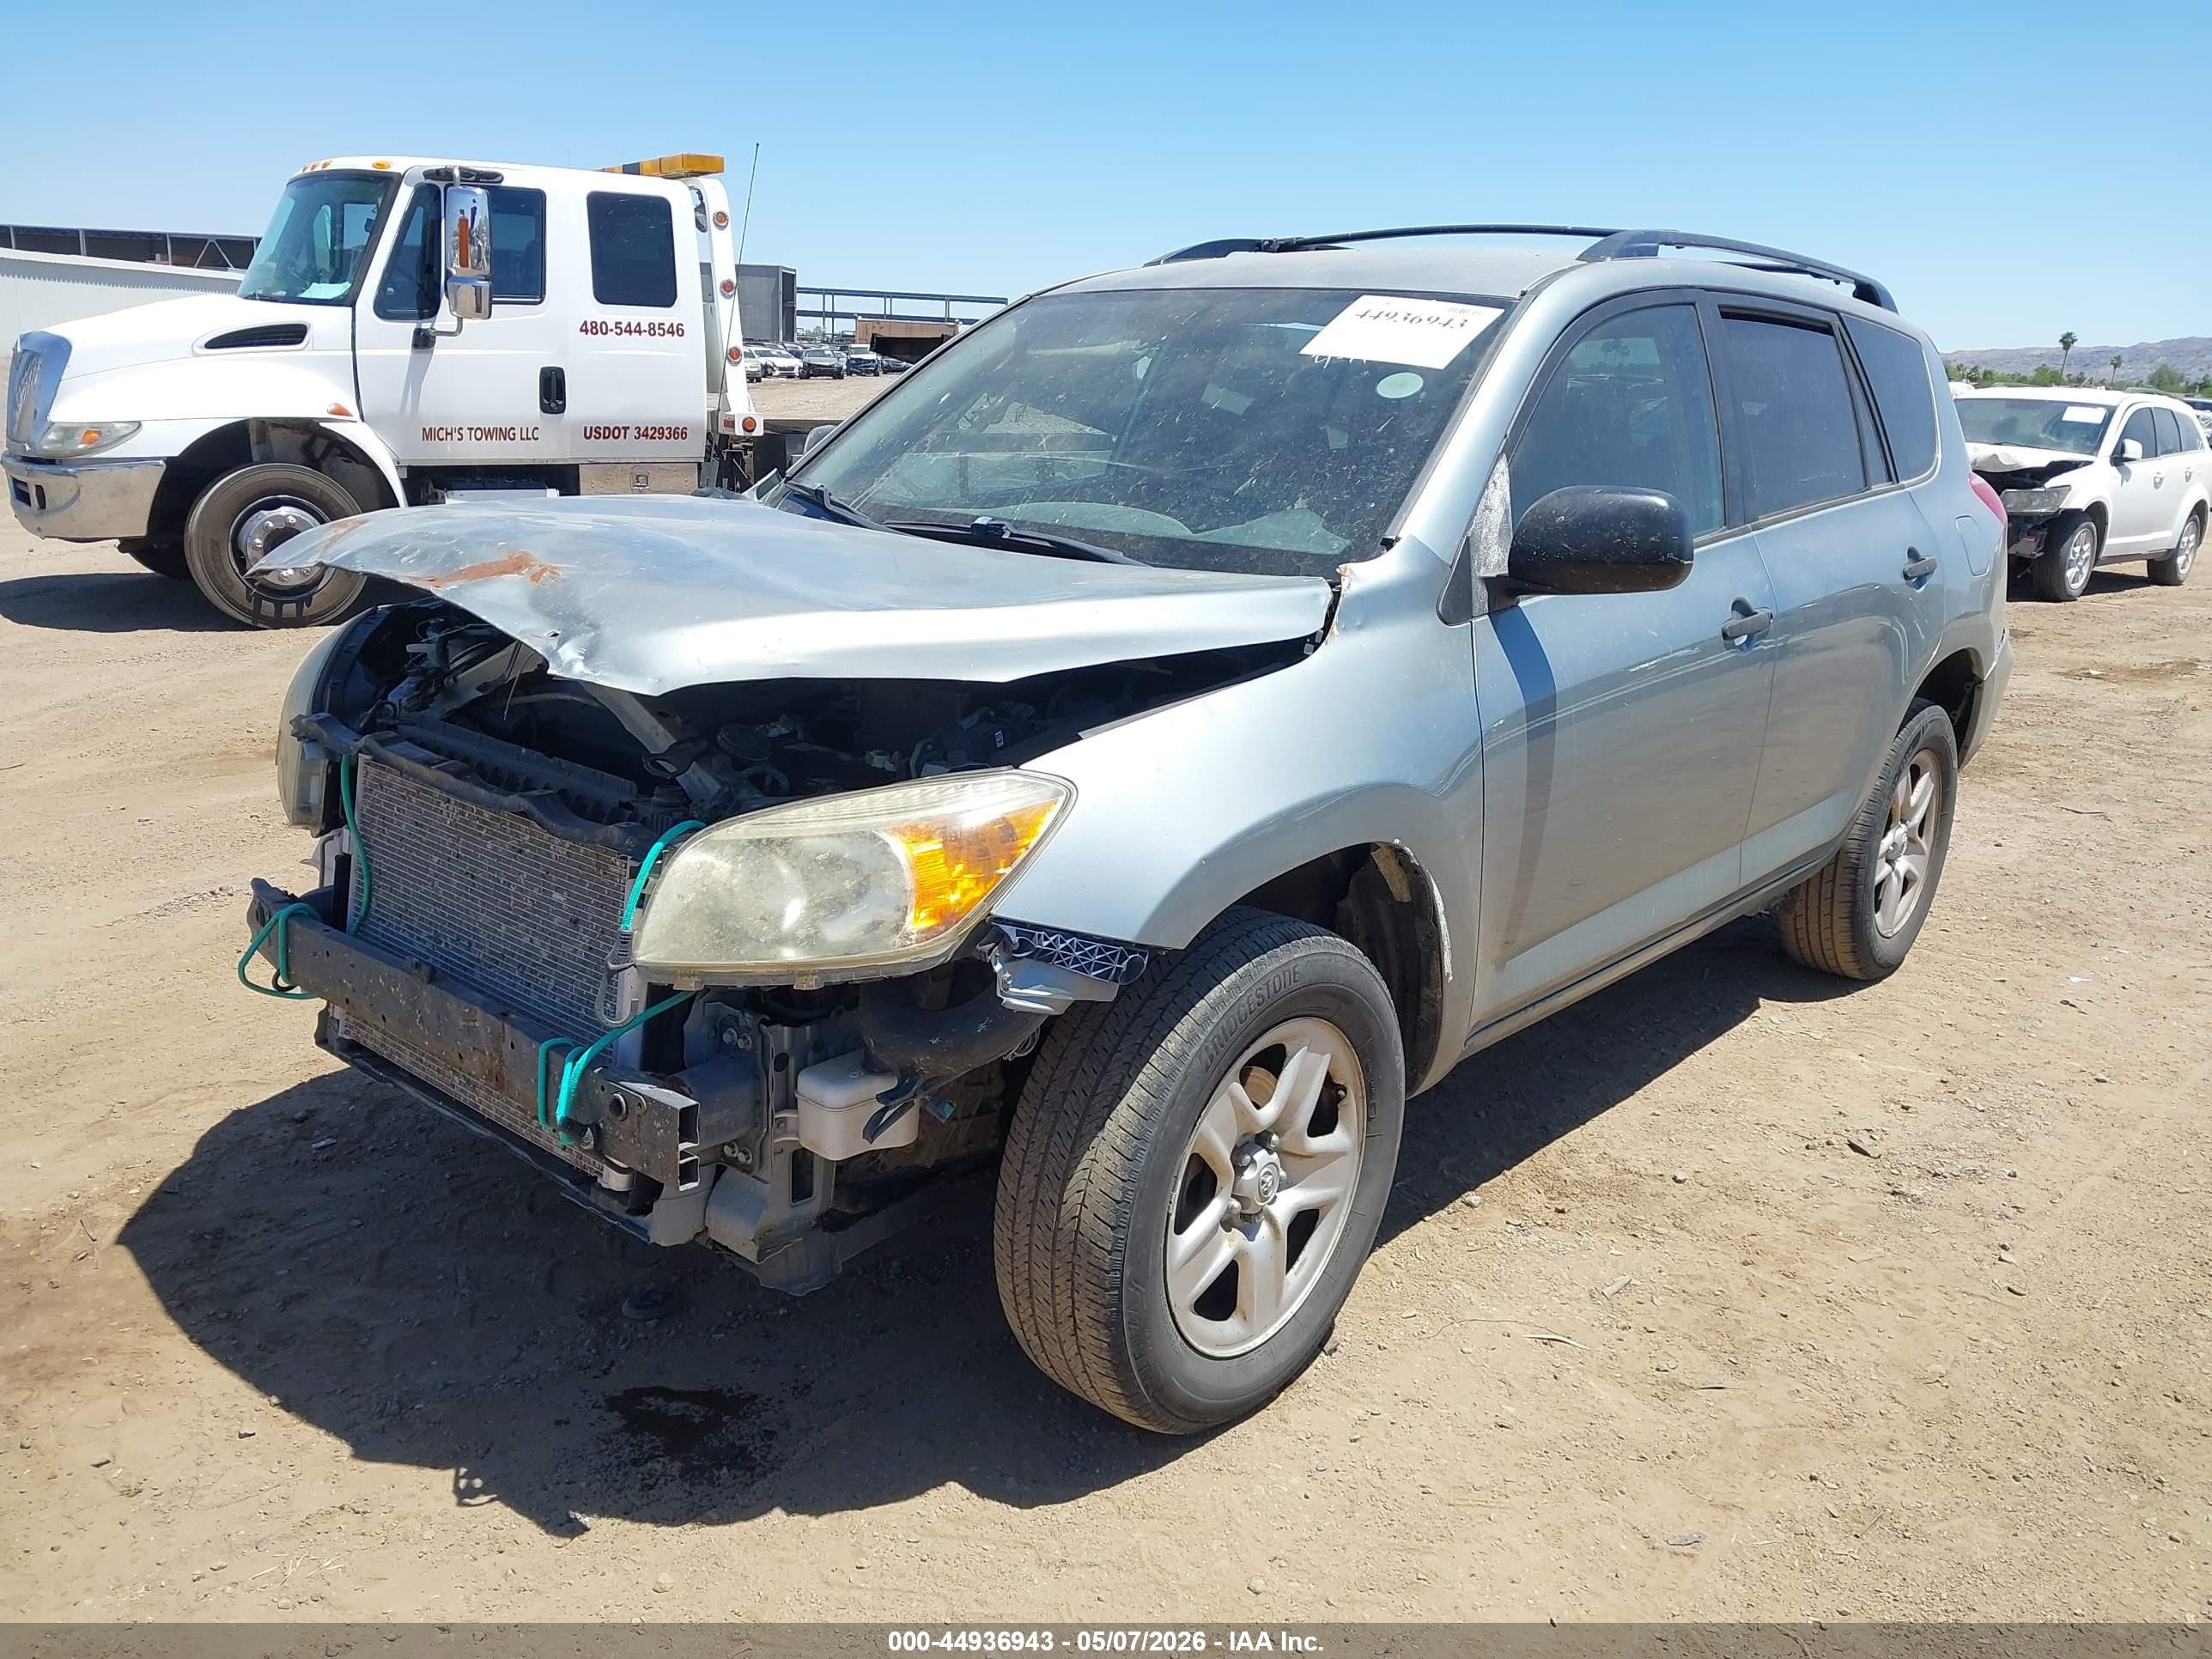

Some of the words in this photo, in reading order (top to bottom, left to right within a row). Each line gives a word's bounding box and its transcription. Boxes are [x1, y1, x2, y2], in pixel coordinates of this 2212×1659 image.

[1355, 308, 1468, 329] 44936943
[579, 320, 685, 337] 480-544-8546
[422, 426, 464, 441] MICH'S
[467, 426, 517, 441] TOWING
[520, 426, 540, 441] LLC
[583, 426, 630, 440] USDOT
[634, 426, 689, 441] 3429366
[1202, 963, 1299, 1073] BRIDGESTONE
